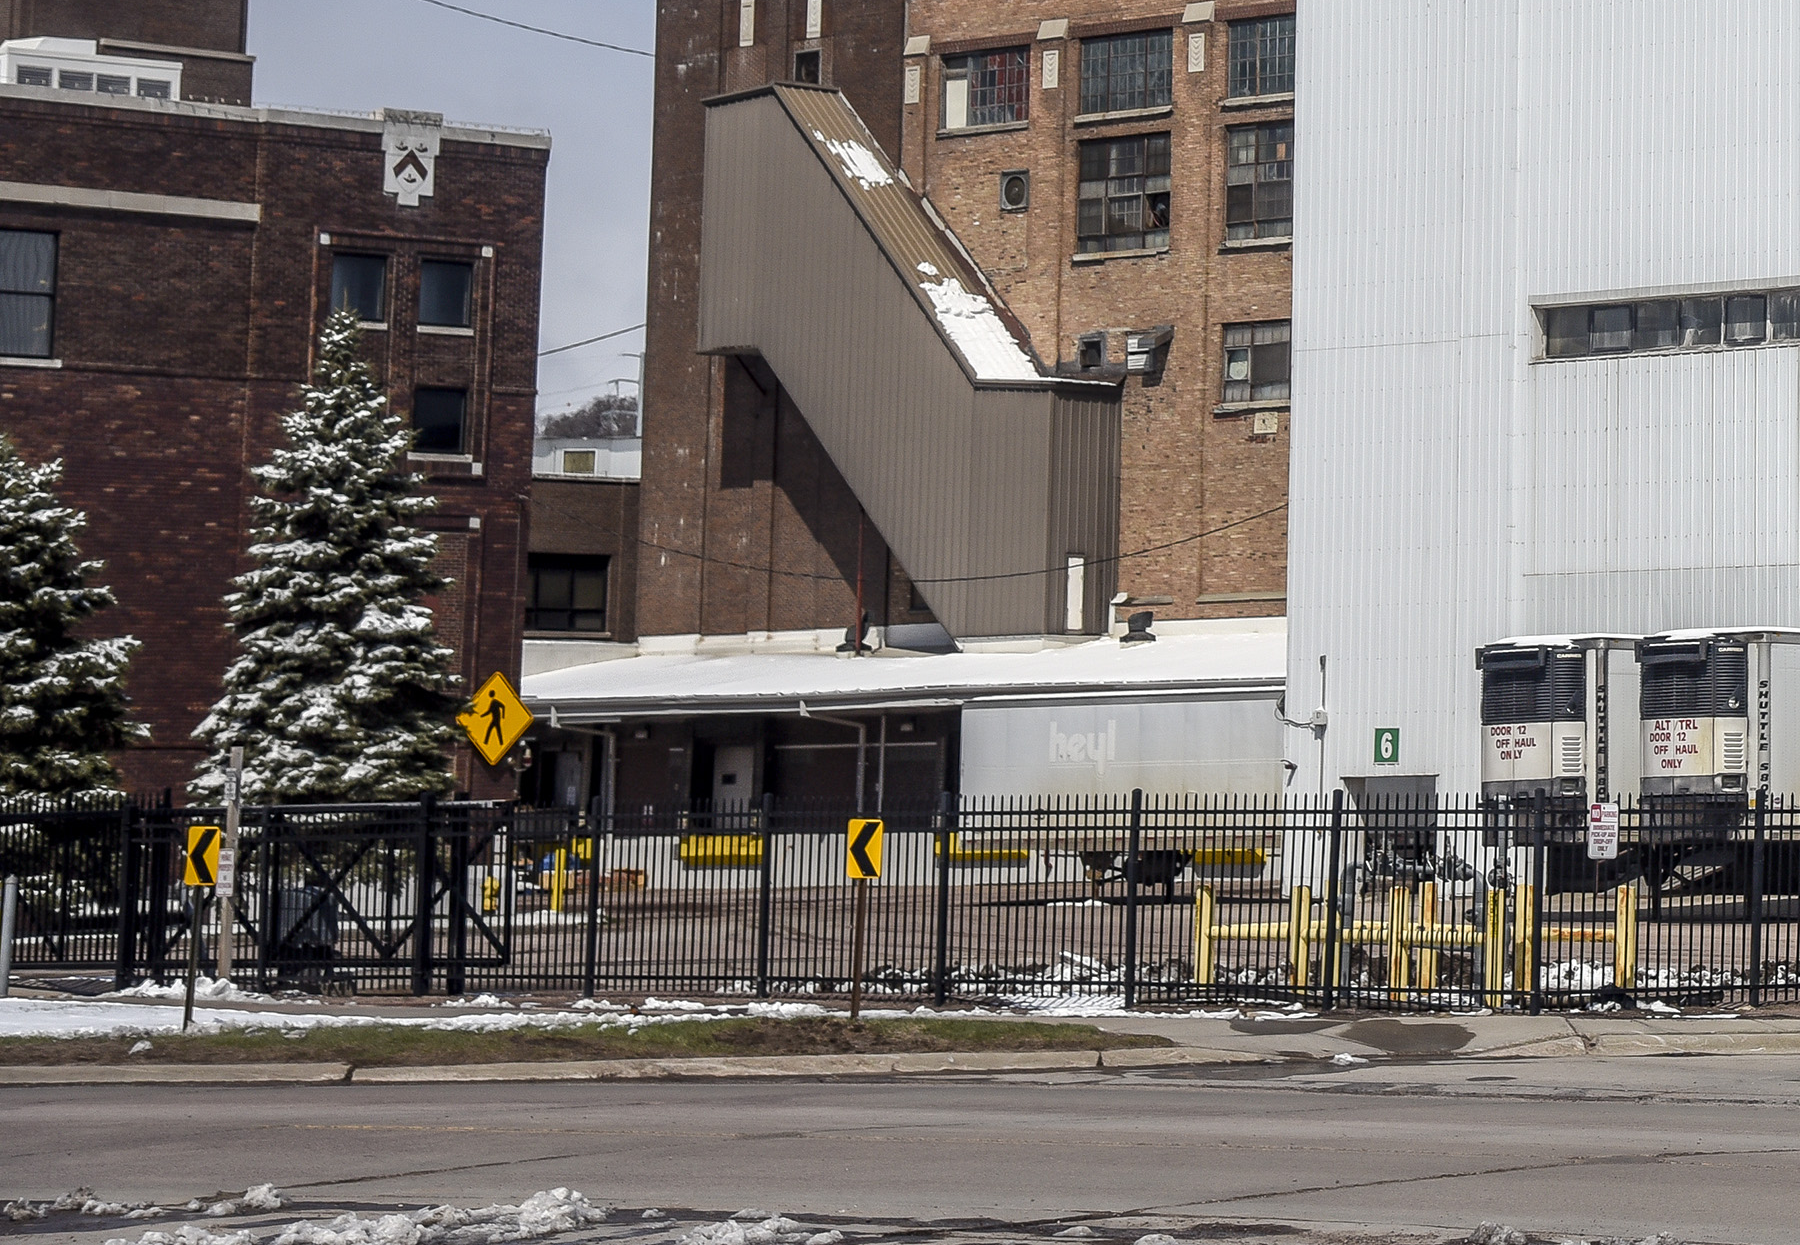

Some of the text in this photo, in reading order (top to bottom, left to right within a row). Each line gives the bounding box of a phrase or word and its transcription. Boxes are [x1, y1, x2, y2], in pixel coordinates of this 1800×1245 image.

[1759, 680, 1769, 751] SHUTTLE
[1490, 725, 1527, 736] DOOR 12
[1650, 732, 1686, 742] DOOR 12
[1049, 720, 1116, 775] heyl
[1380, 732, 1393, 759] 6
[1496, 737, 1537, 749] OFF HAUL
[1500, 749, 1523, 760] ONLY
[1653, 744, 1698, 755] OFF HAUL
[1661, 758, 1683, 769] ONLY
